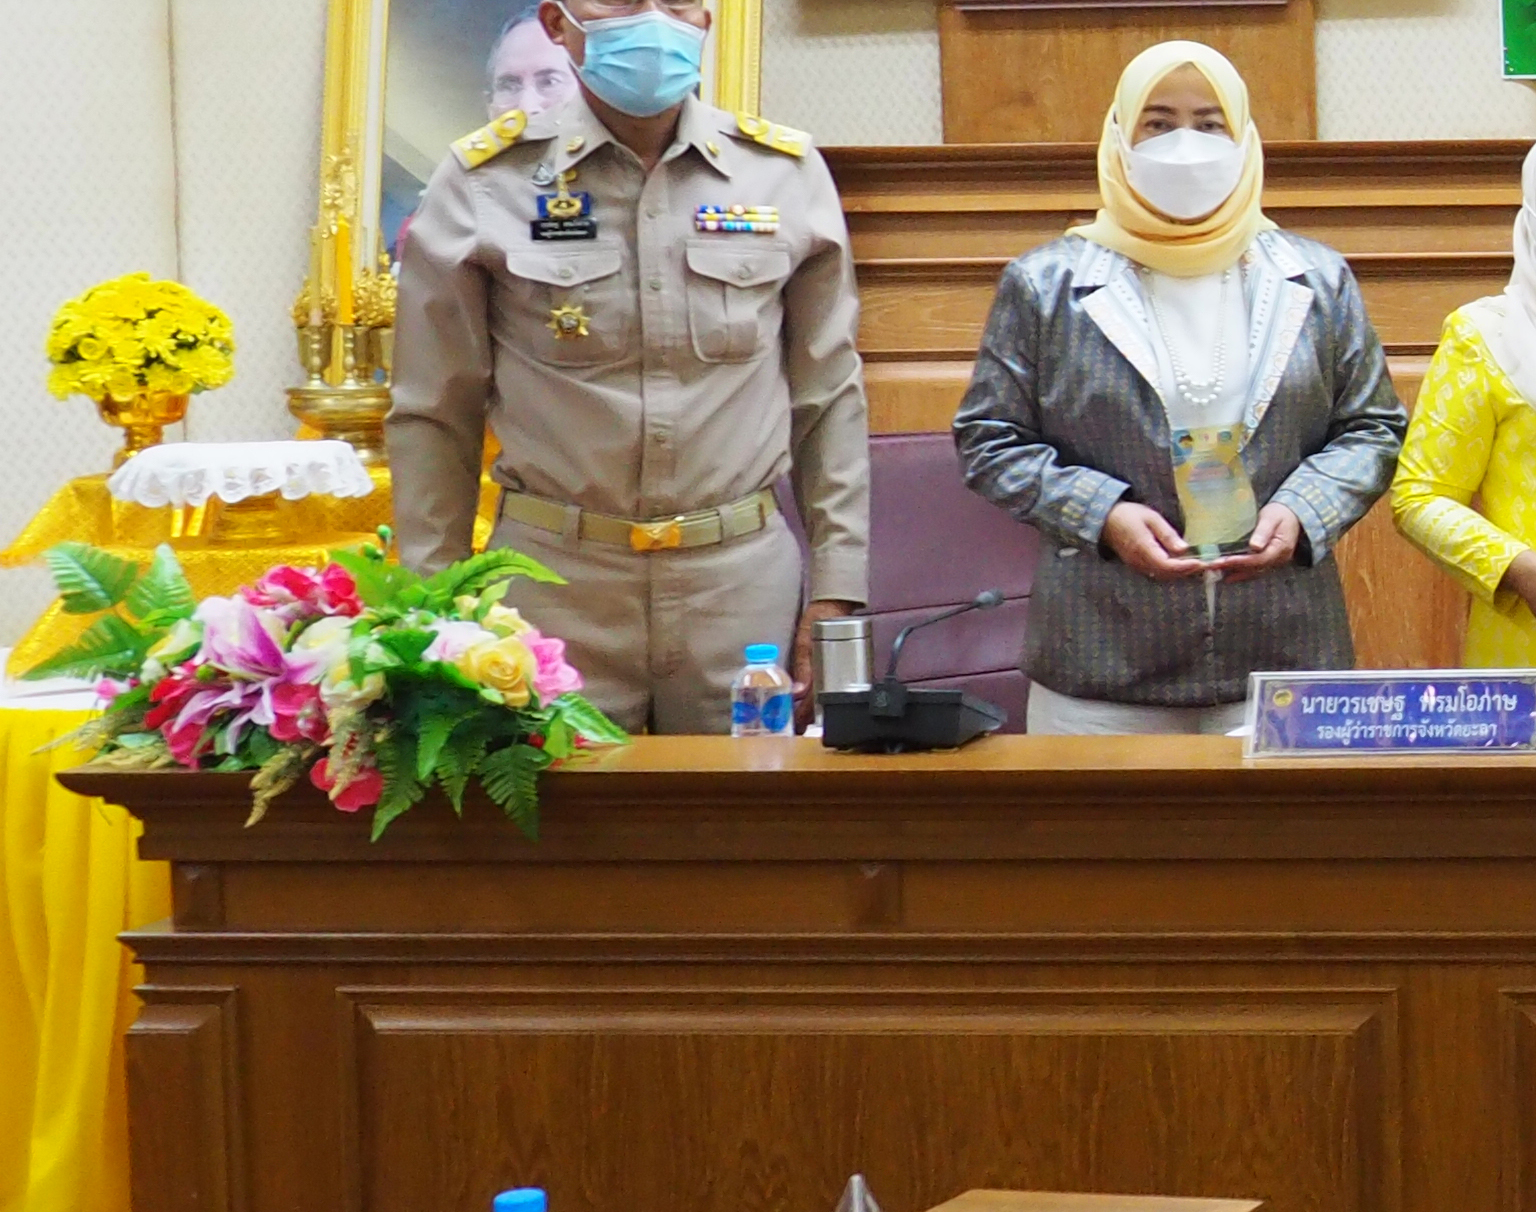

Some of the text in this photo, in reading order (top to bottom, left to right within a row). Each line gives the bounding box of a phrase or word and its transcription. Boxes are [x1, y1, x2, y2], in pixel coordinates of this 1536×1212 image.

[1316, 718, 1498, 746] รองผู้ว่าราชการจังหวัดยะลา
